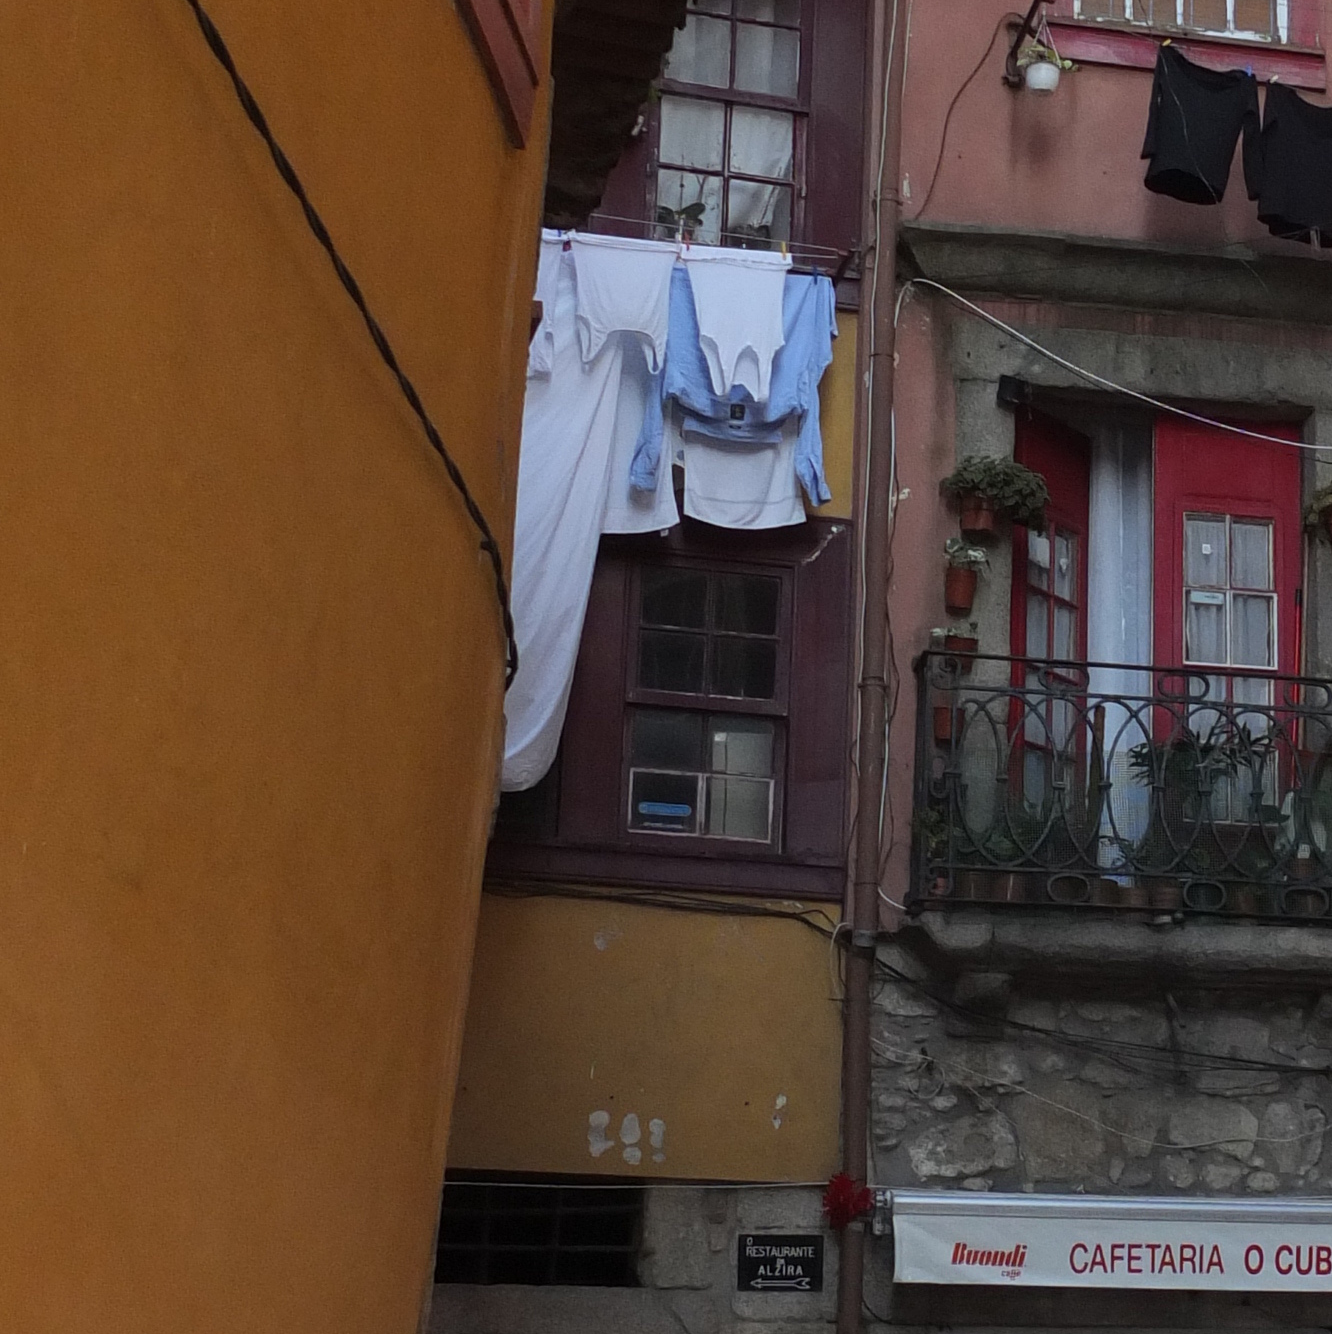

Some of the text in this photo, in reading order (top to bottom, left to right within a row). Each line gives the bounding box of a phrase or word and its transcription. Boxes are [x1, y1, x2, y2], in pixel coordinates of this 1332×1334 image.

[746, 1236, 754, 1246] O
[746, 1246, 815, 1258] RESTAURANTE
[951, 1241, 1028, 1268] Buondi
[1069, 1242, 1225, 1275] CAFETARIA
[1244, 1244, 1265, 1275] O
[758, 1265, 804, 1276] ALZIRA
